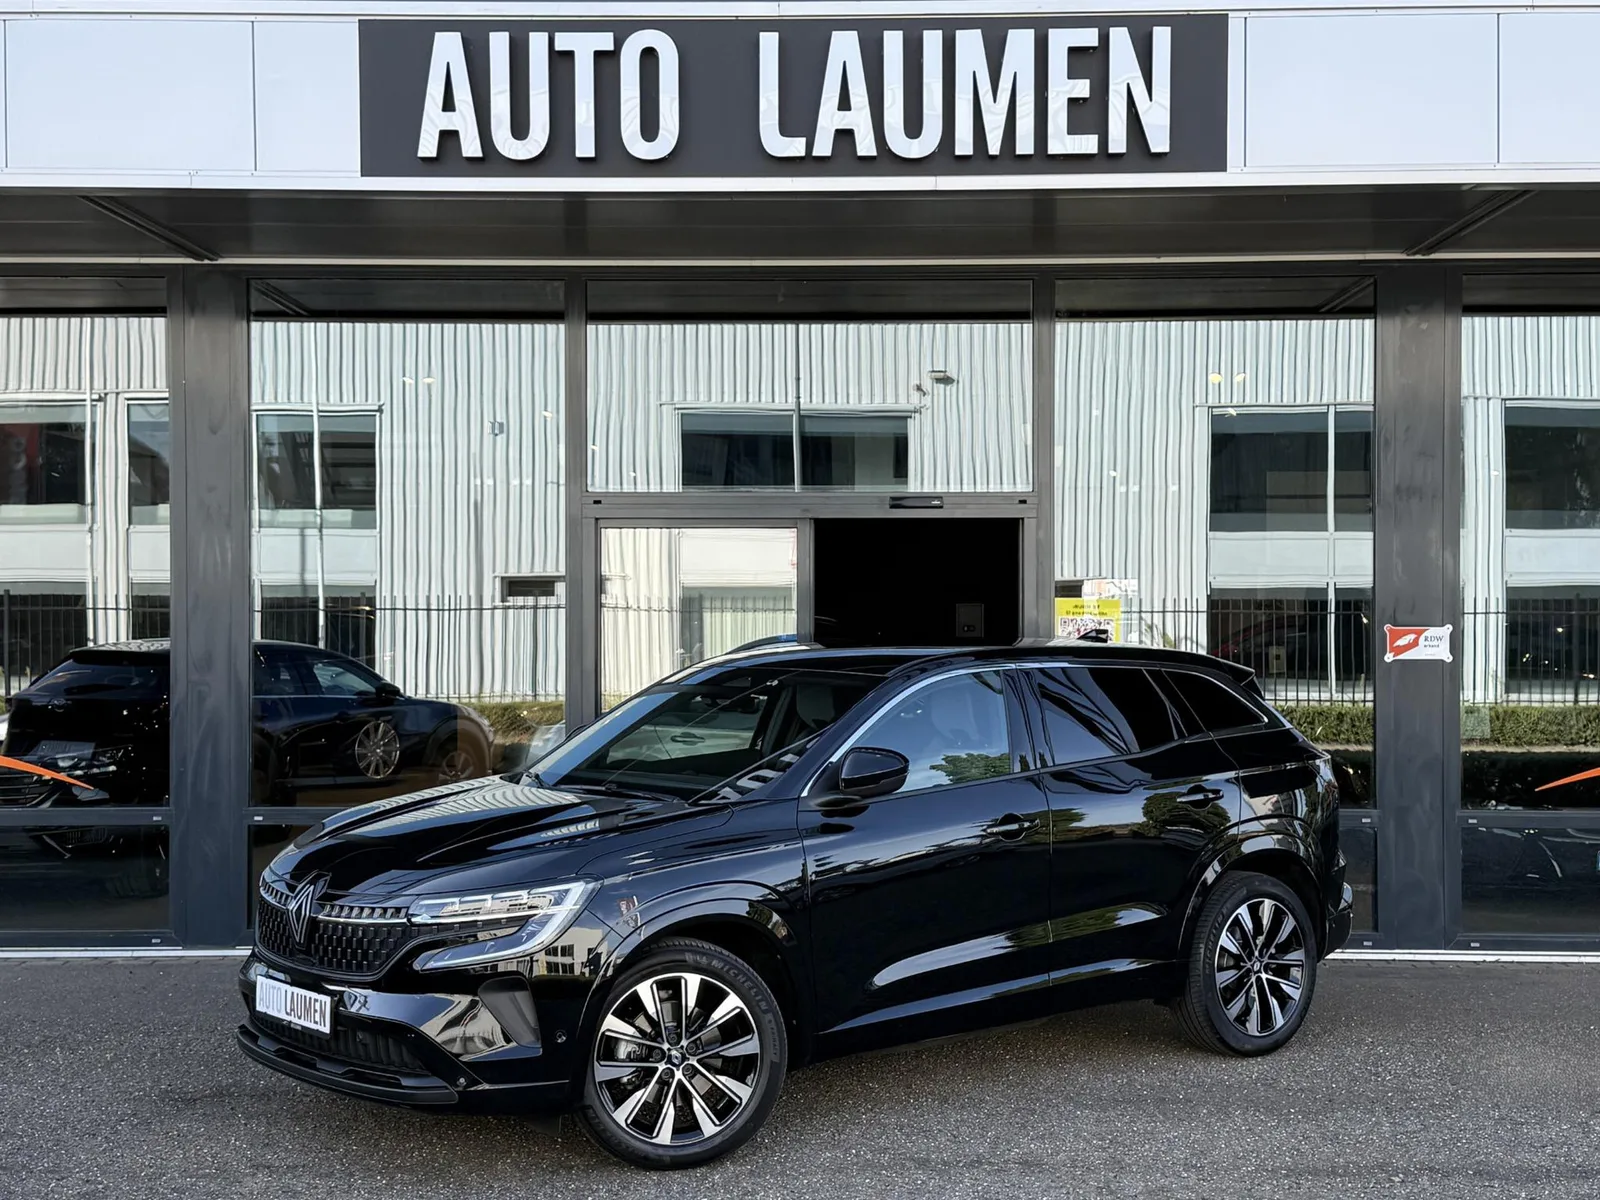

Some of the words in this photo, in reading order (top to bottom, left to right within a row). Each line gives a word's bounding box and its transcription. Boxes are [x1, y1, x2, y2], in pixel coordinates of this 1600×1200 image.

[417, 29, 680, 161] AUTO
[758, 26, 1171, 159] LAUMEN
[259, 981, 282, 1014] AUTO
[284, 989, 327, 1028] LAUMEN
[711, 959, 769, 1011] MICHELIN
